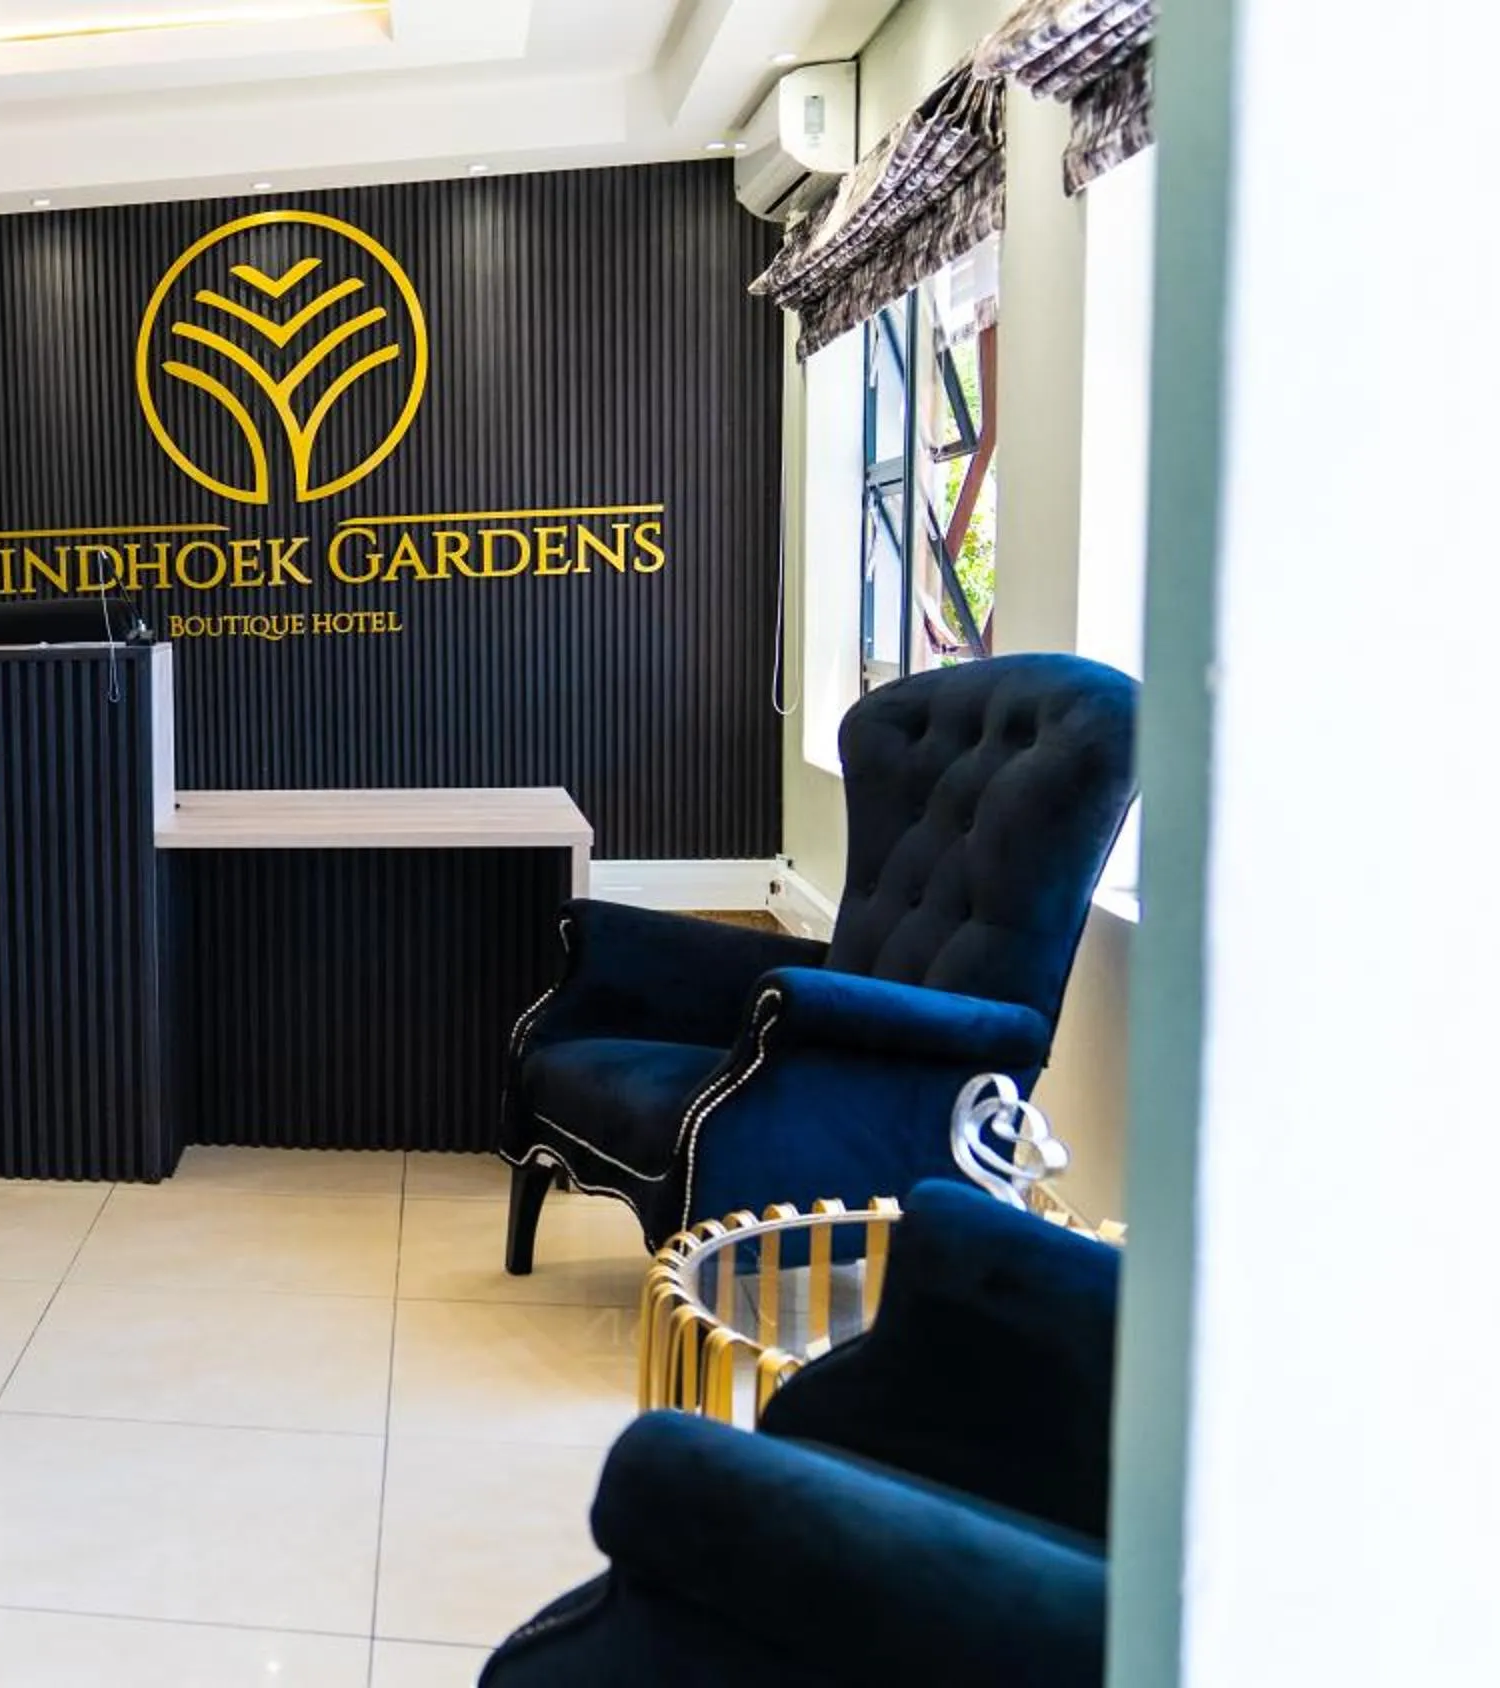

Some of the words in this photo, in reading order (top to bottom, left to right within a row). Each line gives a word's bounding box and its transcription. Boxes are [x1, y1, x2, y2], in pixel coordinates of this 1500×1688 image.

[328, 520, 666, 584] GARDENS
[169, 614, 305, 641] BOUTIQUE
[312, 611, 403, 634] HOTEL
